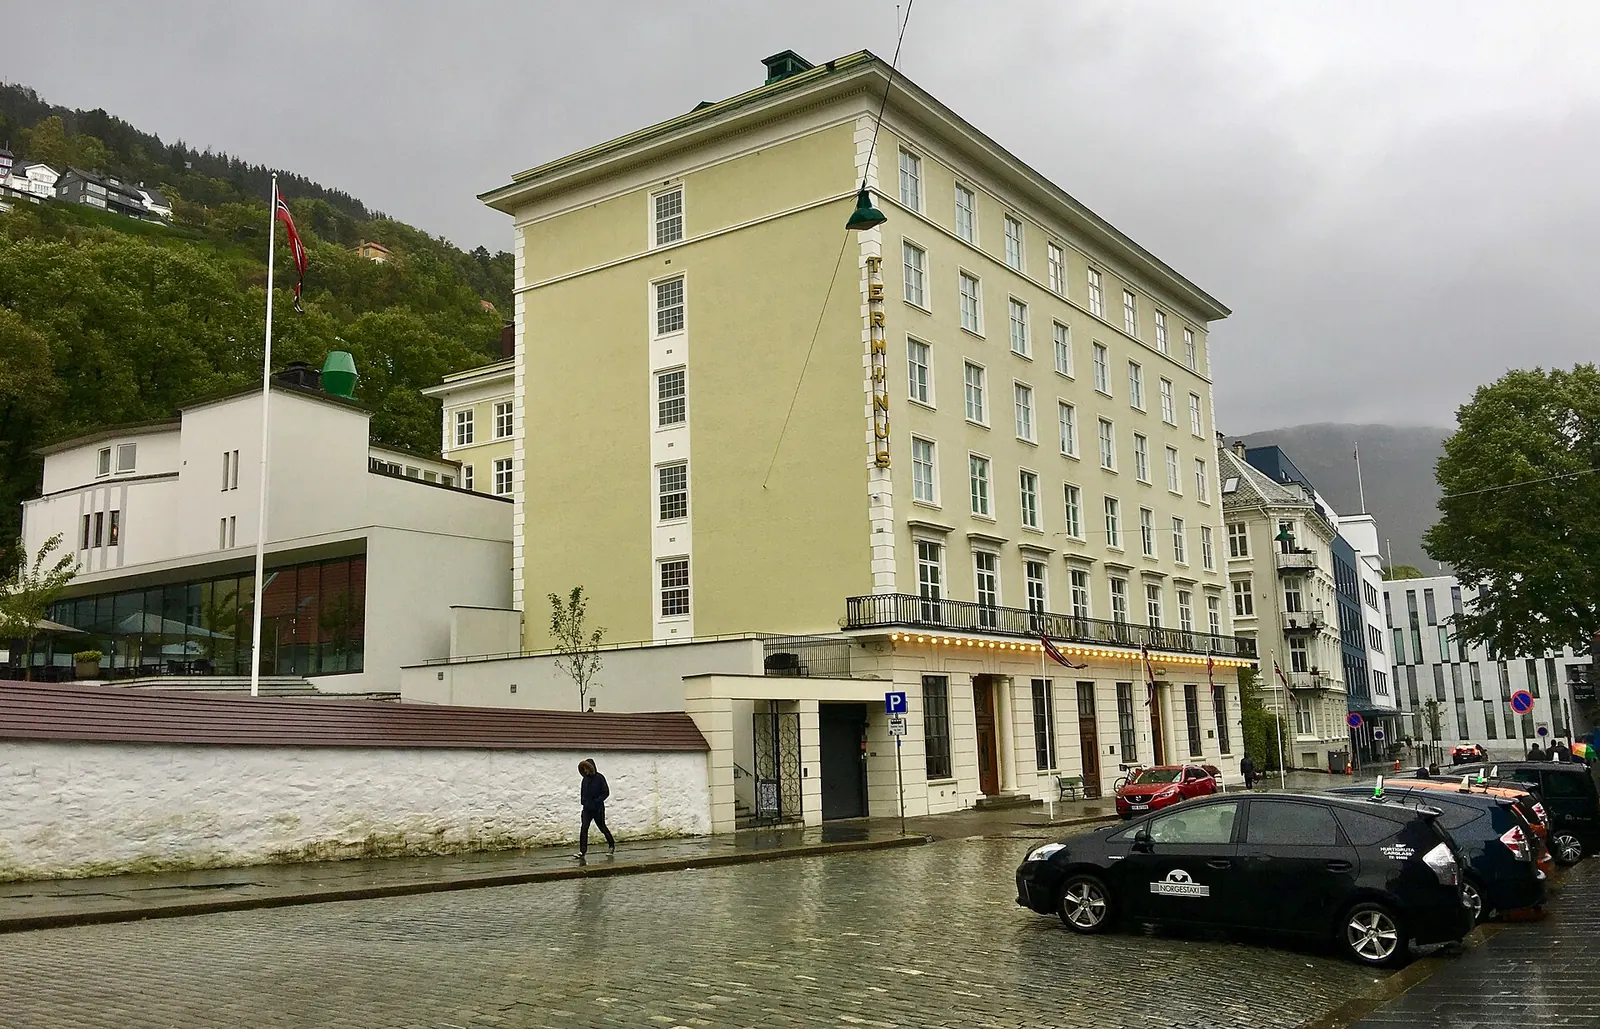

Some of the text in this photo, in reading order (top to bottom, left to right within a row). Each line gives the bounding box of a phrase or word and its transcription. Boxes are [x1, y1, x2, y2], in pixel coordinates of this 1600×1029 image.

[866, 256, 891, 468] TERMINUS
[890, 694, 901, 711] P
[1160, 885, 1200, 894] NORGESTAXI
